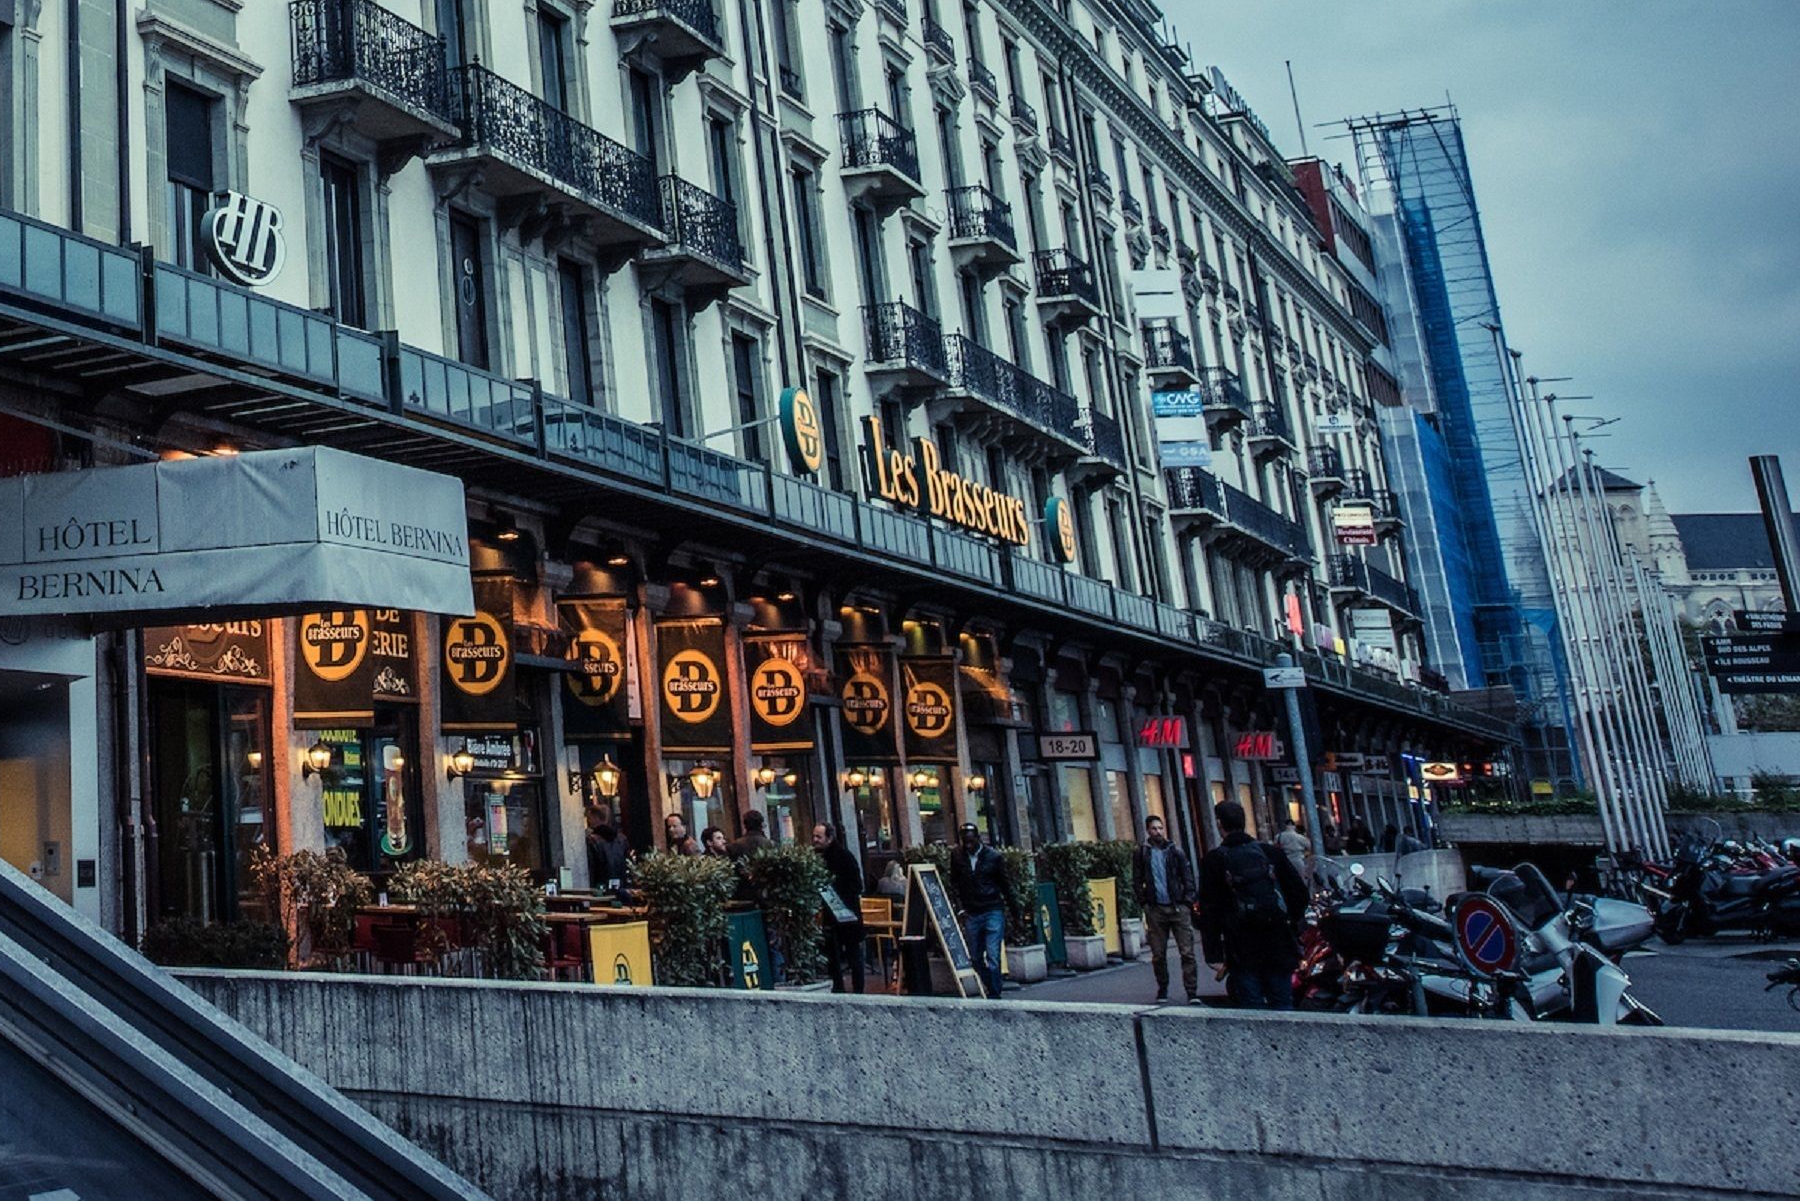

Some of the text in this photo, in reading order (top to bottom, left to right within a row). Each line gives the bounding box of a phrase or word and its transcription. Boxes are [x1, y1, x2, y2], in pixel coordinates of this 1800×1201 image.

[864, 416, 1029, 545] Les Brasseurs
[38, 516, 152, 552] HÔTEL
[327, 507, 464, 558] HÔTEL BERNINA
[17, 568, 165, 600] BERNINA
[320, 619, 331, 628] Les
[307, 626, 360, 641] Brasseurs
[451, 645, 502, 660] Brasseurs
[584, 661, 616, 675] sseurs
[668, 678, 715, 693] Brasseurs
[757, 686, 799, 698] Brasseurs
[1139, 718, 1182, 746] H&M
[1048, 740, 1087, 754] 18-20
[1234, 735, 1273, 758] H&M
[323, 790, 361, 827] ONDUES
